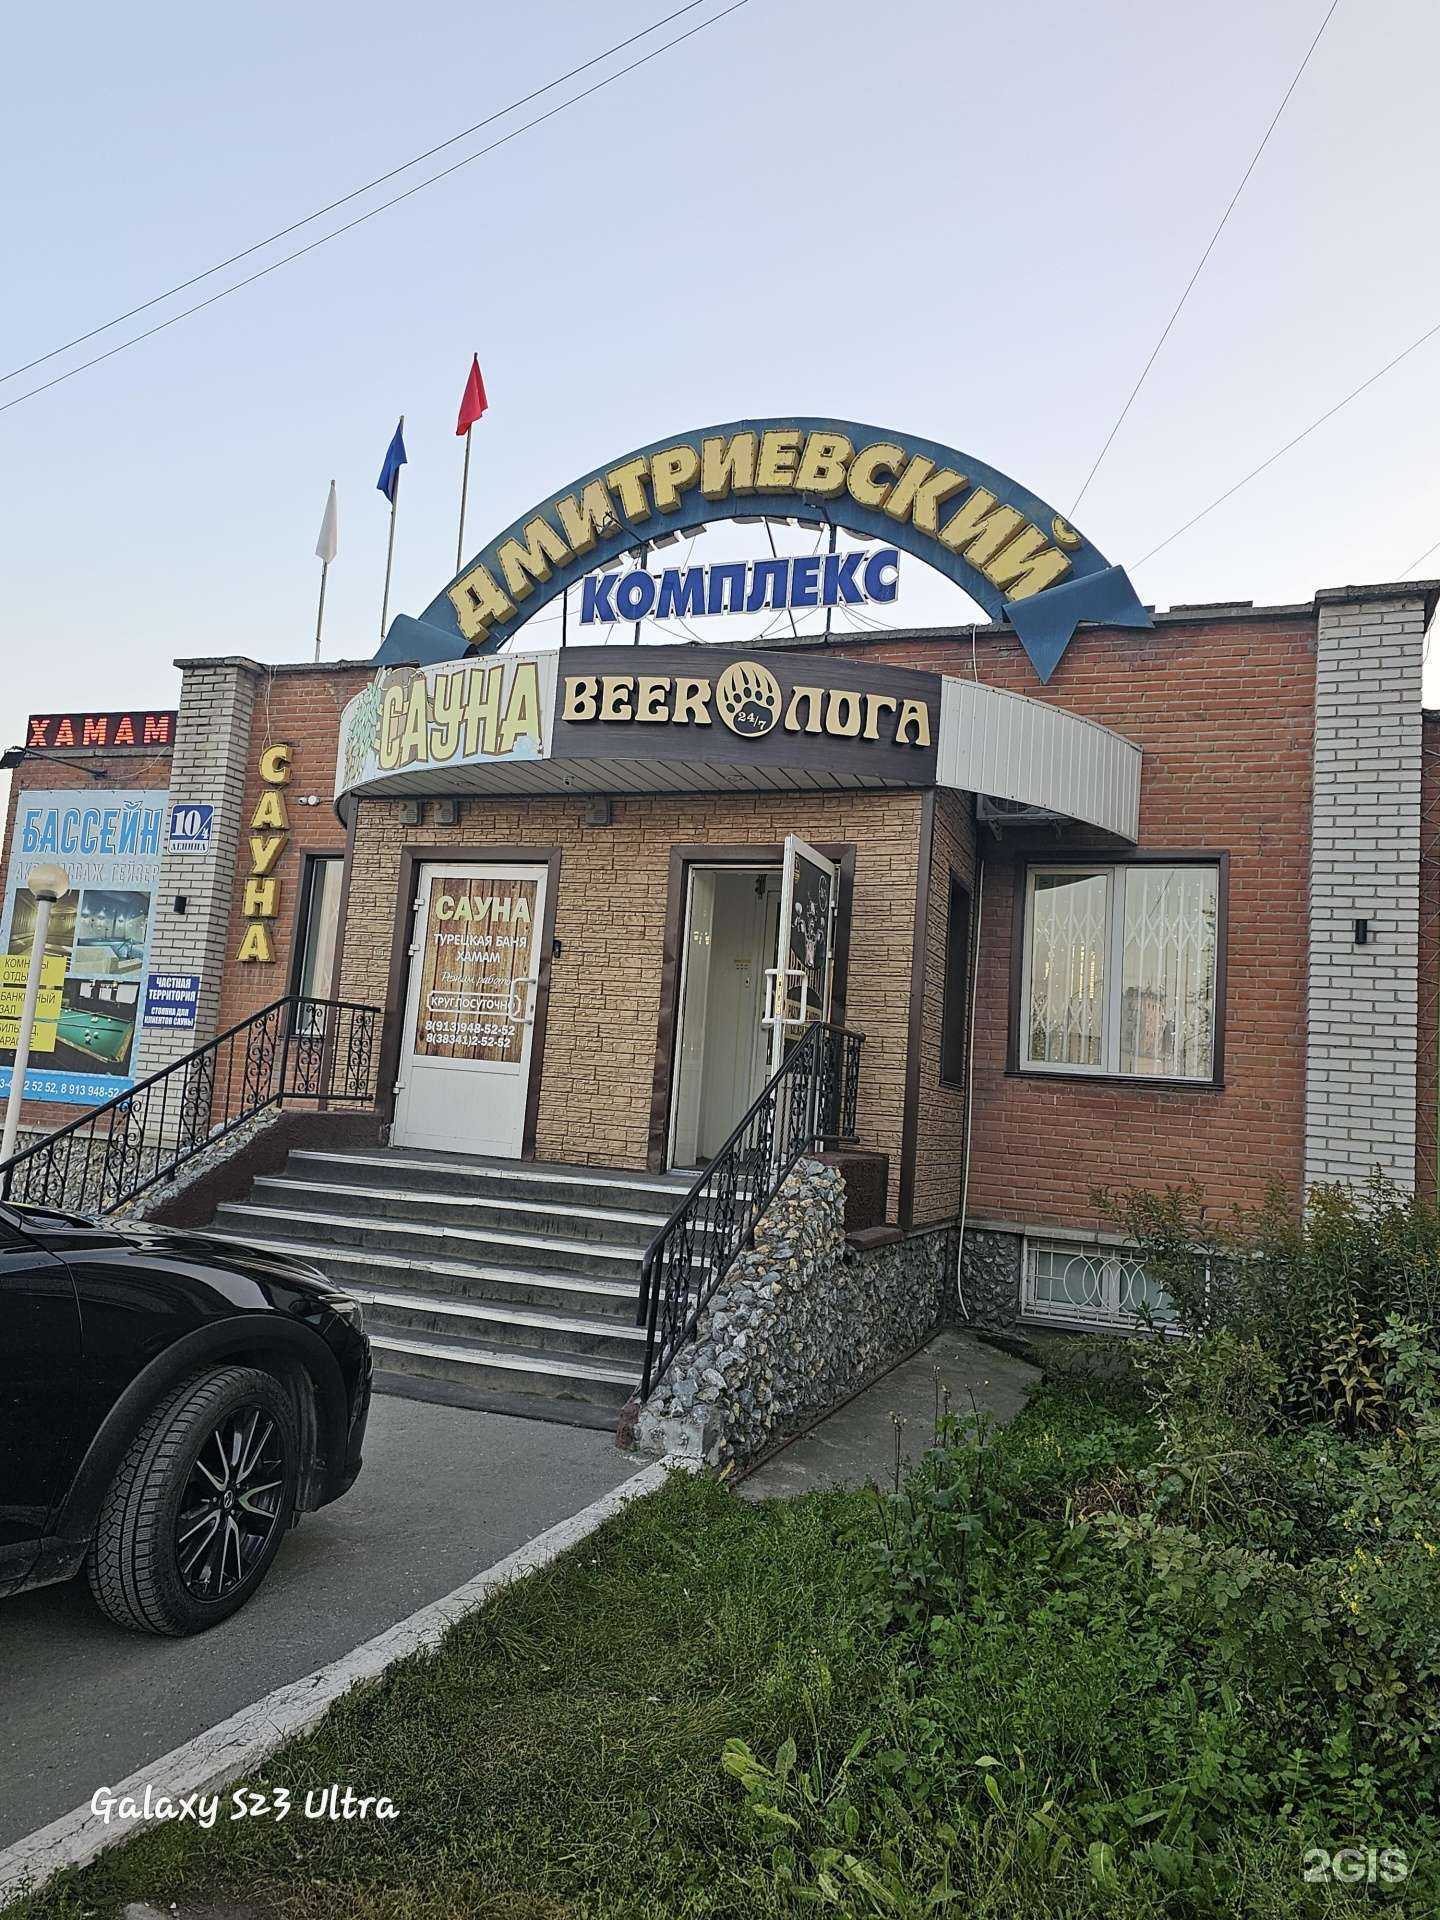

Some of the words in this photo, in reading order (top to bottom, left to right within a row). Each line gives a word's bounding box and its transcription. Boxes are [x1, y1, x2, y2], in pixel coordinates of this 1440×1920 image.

[448, 428, 1081, 646] ДМИТРИЕВСКИЙ
[579, 546, 900, 626] КОМПЛЕКС
[562, 676, 711, 725] BEER
[378, 662, 543, 771] САУНА
[737, 711, 767, 731] 24/7
[784, 685, 930, 746] ЛОГА
[28, 716, 170, 747] ХАМАМ
[22, 801, 164, 857] БАССЕЙН
[235, 744, 292, 963] САУНА
[435, 895, 531, 923] САУНА
[433, 933, 493, 948] ТУРЕЦКАЯ
[495, 936, 528, 948] БАНЯ
[4, 958, 49, 970] КОМНЫ
[457, 951, 500, 963] ХАМАМ
[156, 977, 191, 989] ЧАСТНАЯ
[1, 991, 56, 1004] БАНКНЫЙ
[149, 989, 196, 1002] ТЕРРИТОРИЯ
[425, 1020, 515, 1036] 8(913)948-52-52
[426, 1033, 511, 1048] 8(38341)2-52-52
[31, 1081, 43, 1092] 52
[60, 1083, 67, 1094] 8
[69, 1085, 86, 1096] 913
